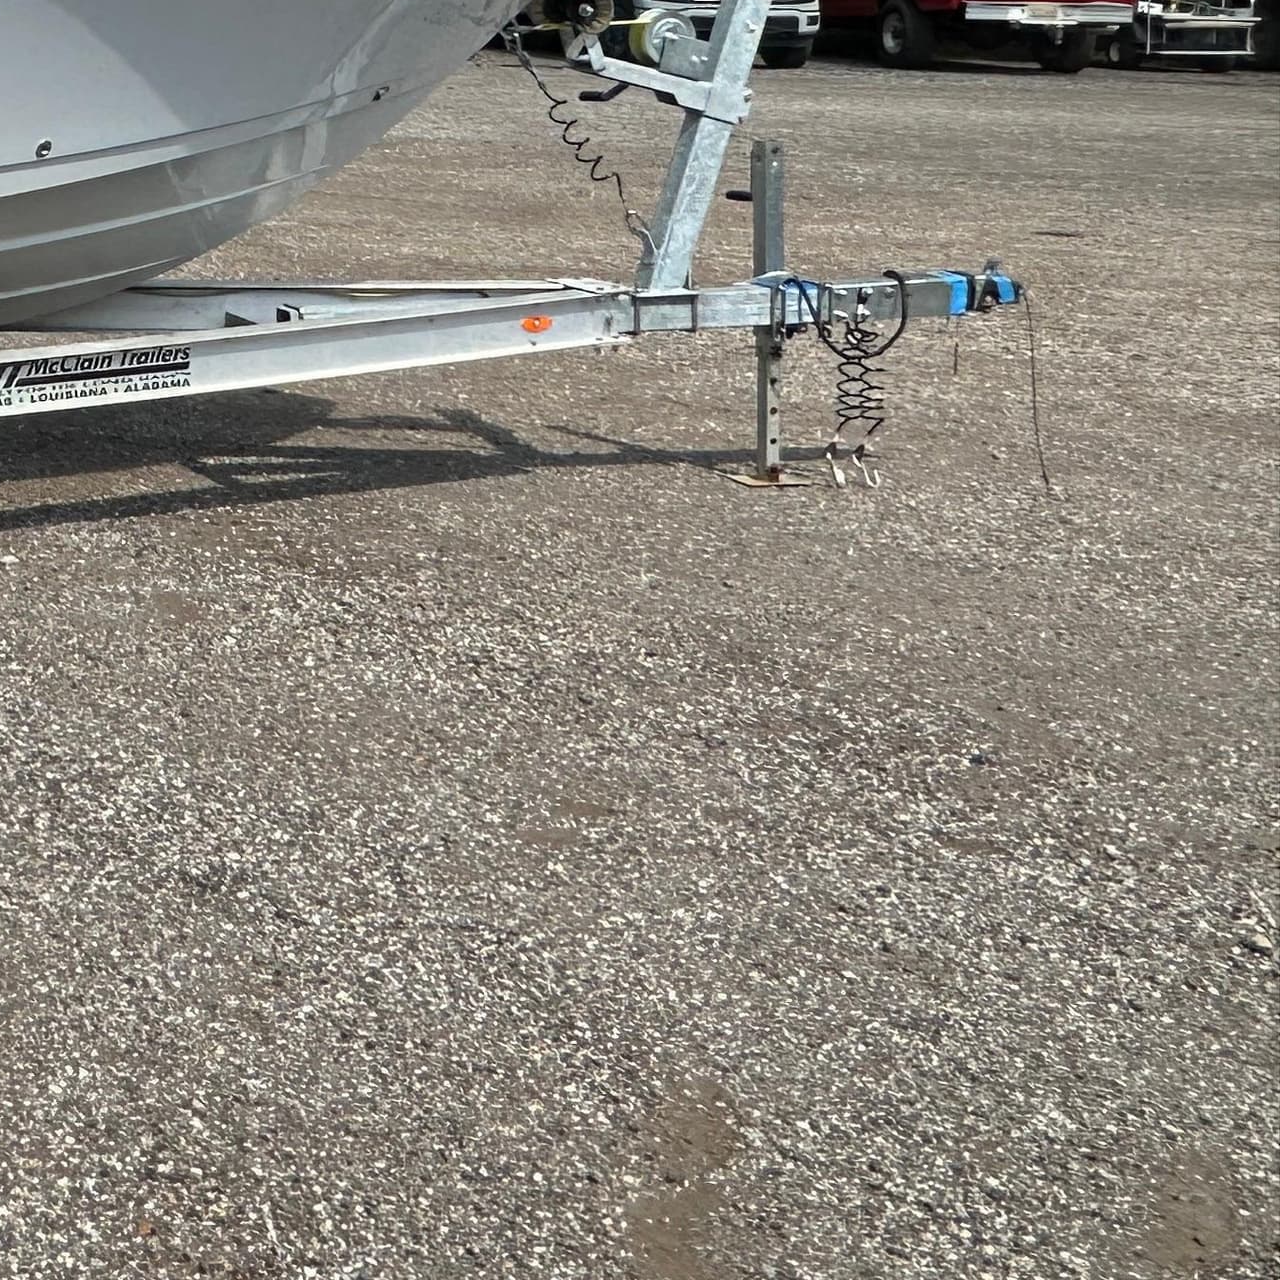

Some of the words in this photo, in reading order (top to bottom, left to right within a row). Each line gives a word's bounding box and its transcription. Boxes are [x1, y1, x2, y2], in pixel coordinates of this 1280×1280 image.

[26, 352, 113, 376] McClain
[120, 346, 190, 370] Trailers
[29, 386, 108, 404] LOUISIANA
[123, 377, 191, 393] ALABAMA
